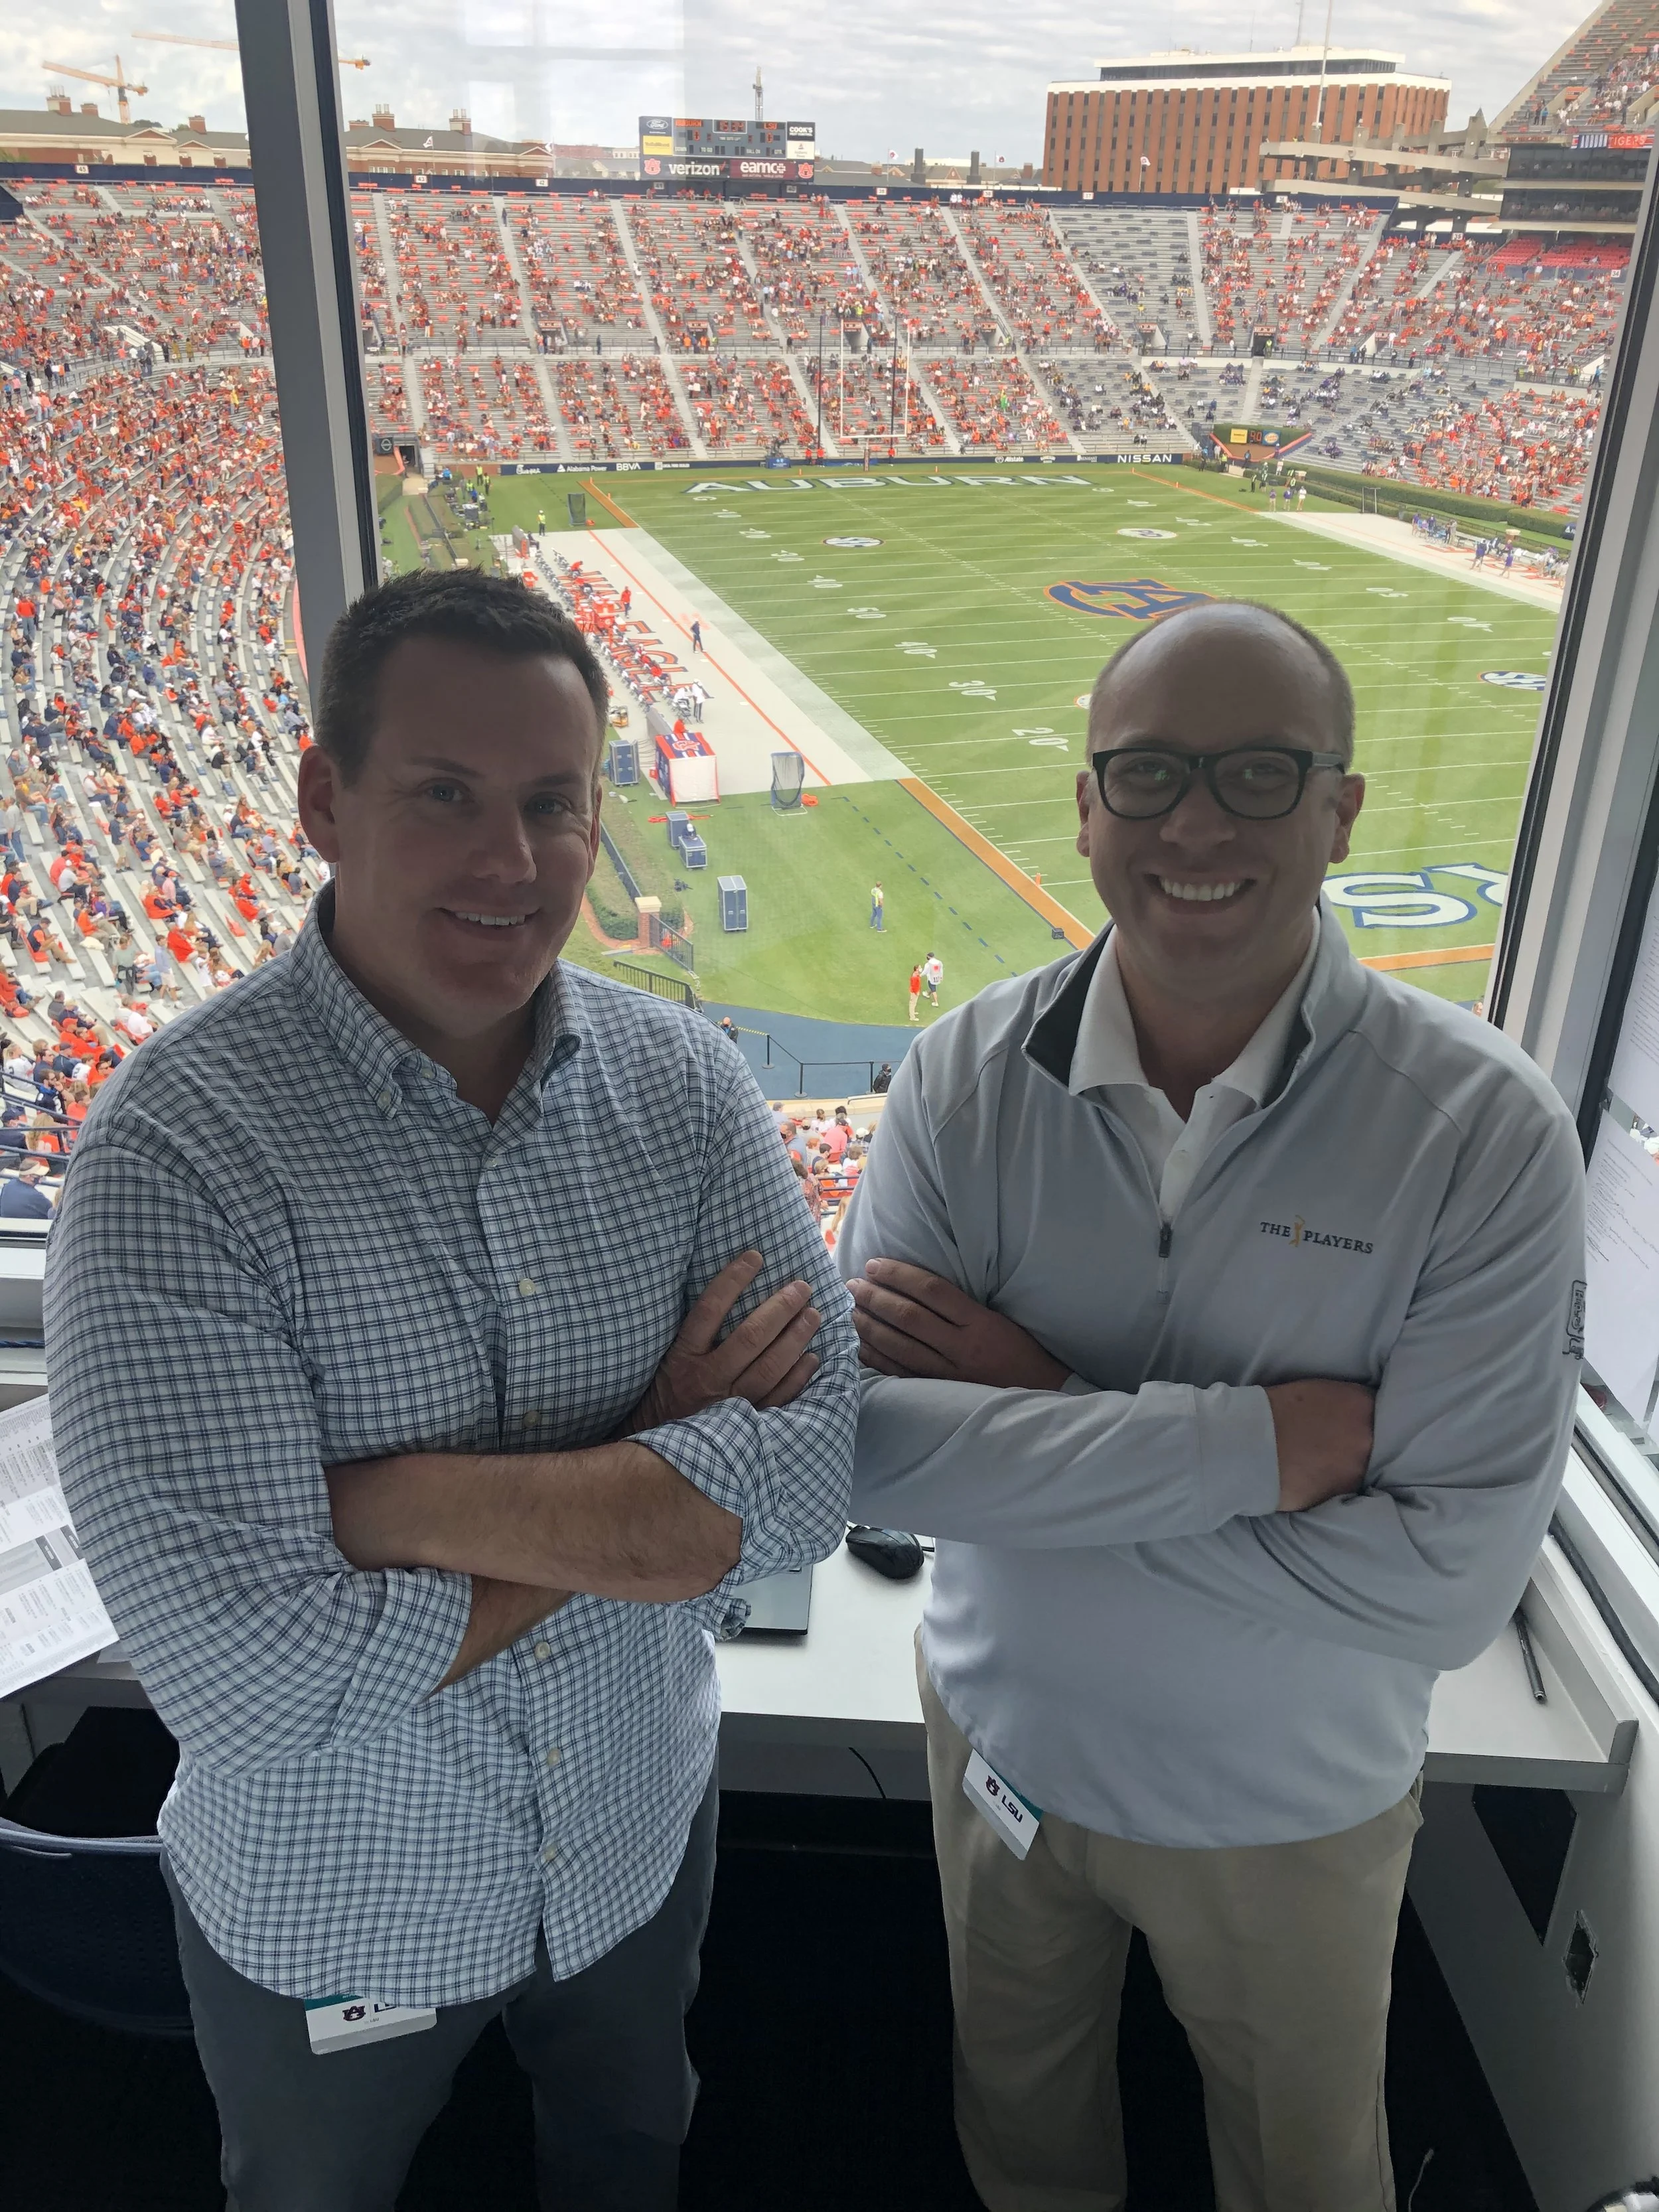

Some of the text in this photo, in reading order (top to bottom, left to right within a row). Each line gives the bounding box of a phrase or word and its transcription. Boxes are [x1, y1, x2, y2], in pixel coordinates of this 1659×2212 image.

[1609, 134, 1647, 147] TIGERS
[669, 161, 720, 176] verizon
[741, 162, 777, 174] eamc
[1118, 454, 1172, 463] NISSAN
[616, 463, 641, 471] BBVA
[682, 476, 1097, 494] AUBURN
[847, 607, 887, 619] 50
[894, 641, 938, 654] 40
[948, 680, 997, 696] 30
[1011, 727, 1069, 746] 20
[1260, 1222, 1374, 1254] THE PLAYERS
[1001, 1795, 1023, 1823] LSU
